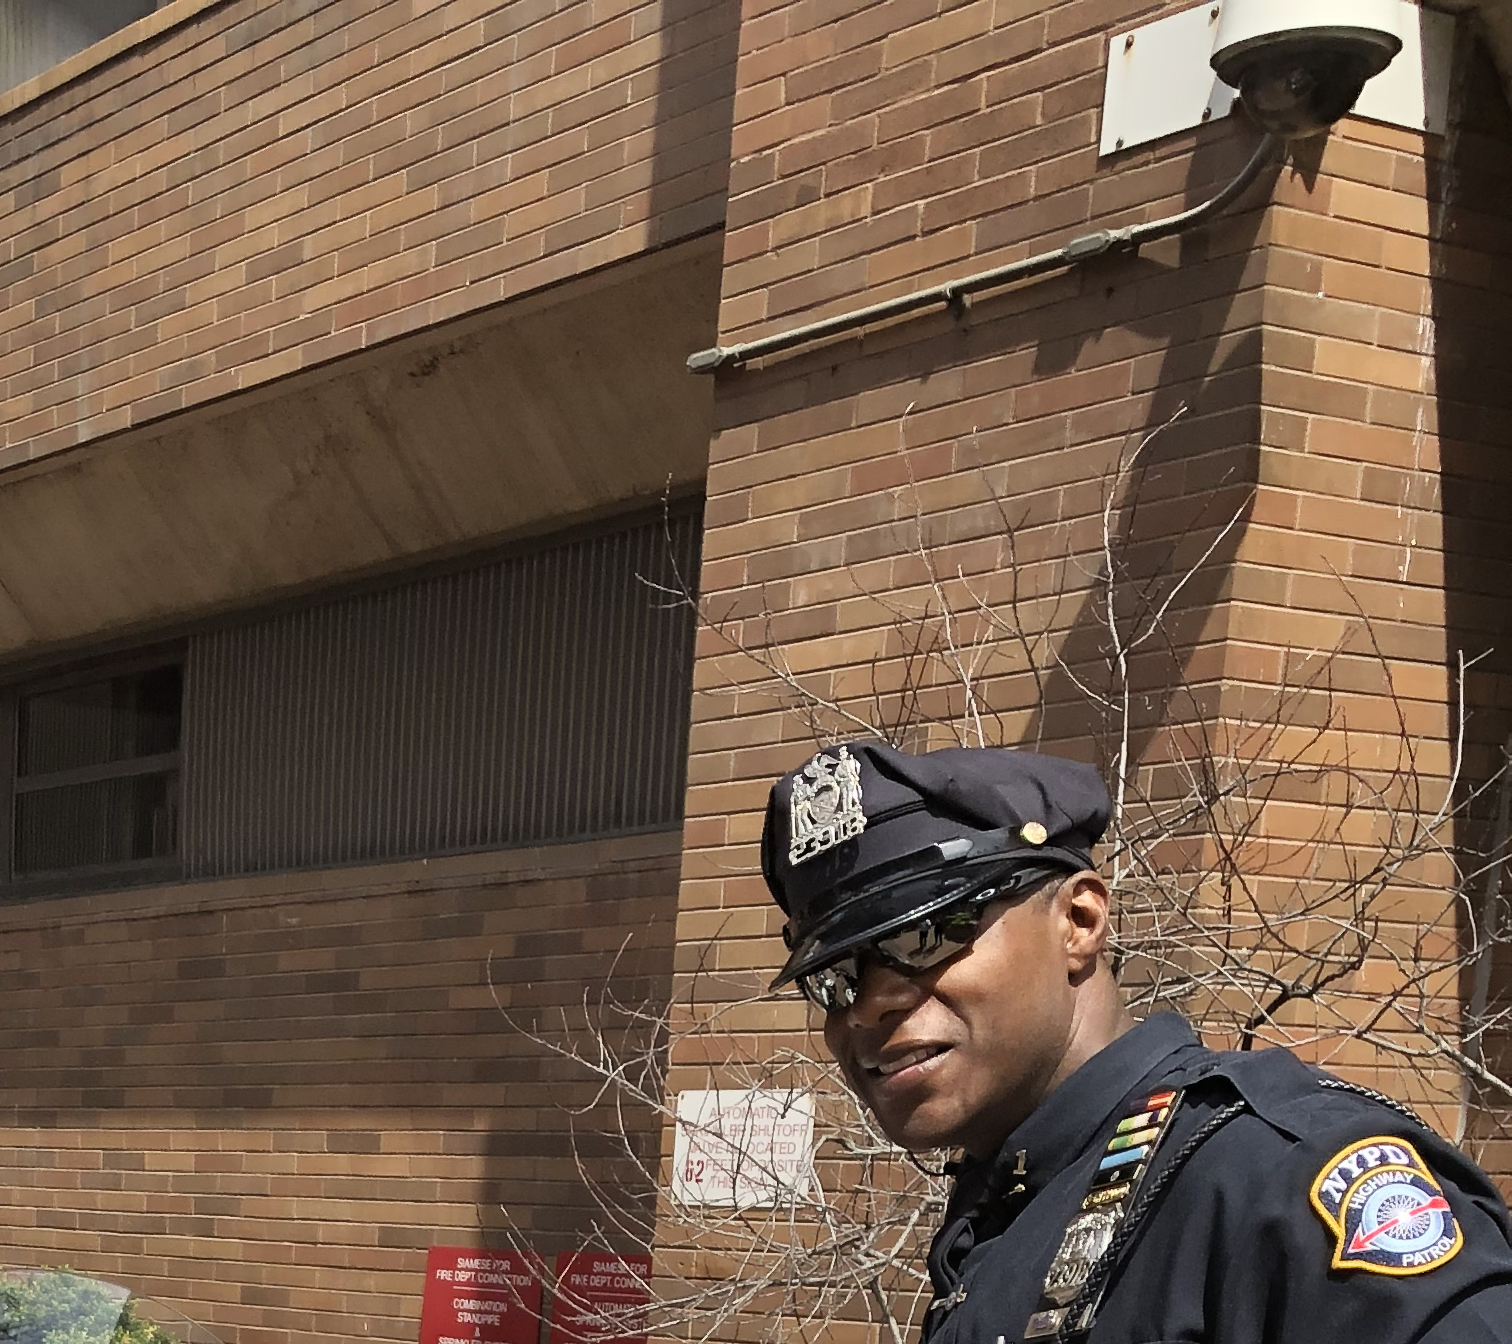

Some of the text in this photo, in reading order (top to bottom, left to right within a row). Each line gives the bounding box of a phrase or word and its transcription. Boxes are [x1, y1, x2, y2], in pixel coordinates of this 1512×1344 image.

[1321, 1144, 1409, 1204] NYPD
[1348, 1171, 1414, 1209] HIGHWAY
[1402, 1236, 1456, 1266] PATROL
[457, 1258, 492, 1270] SIAMESE
[631, 1264, 648, 1274] FOR
[435, 1270, 452, 1280] FIRE
[455, 1270, 476, 1282] DEPT.
[571, 1274, 588, 1286] FIRE
[590, 1276, 612, 1287] DEPT.
[453, 1298, 508, 1312] COMBINATION
[456, 1312, 500, 1326] STANDPIPE
